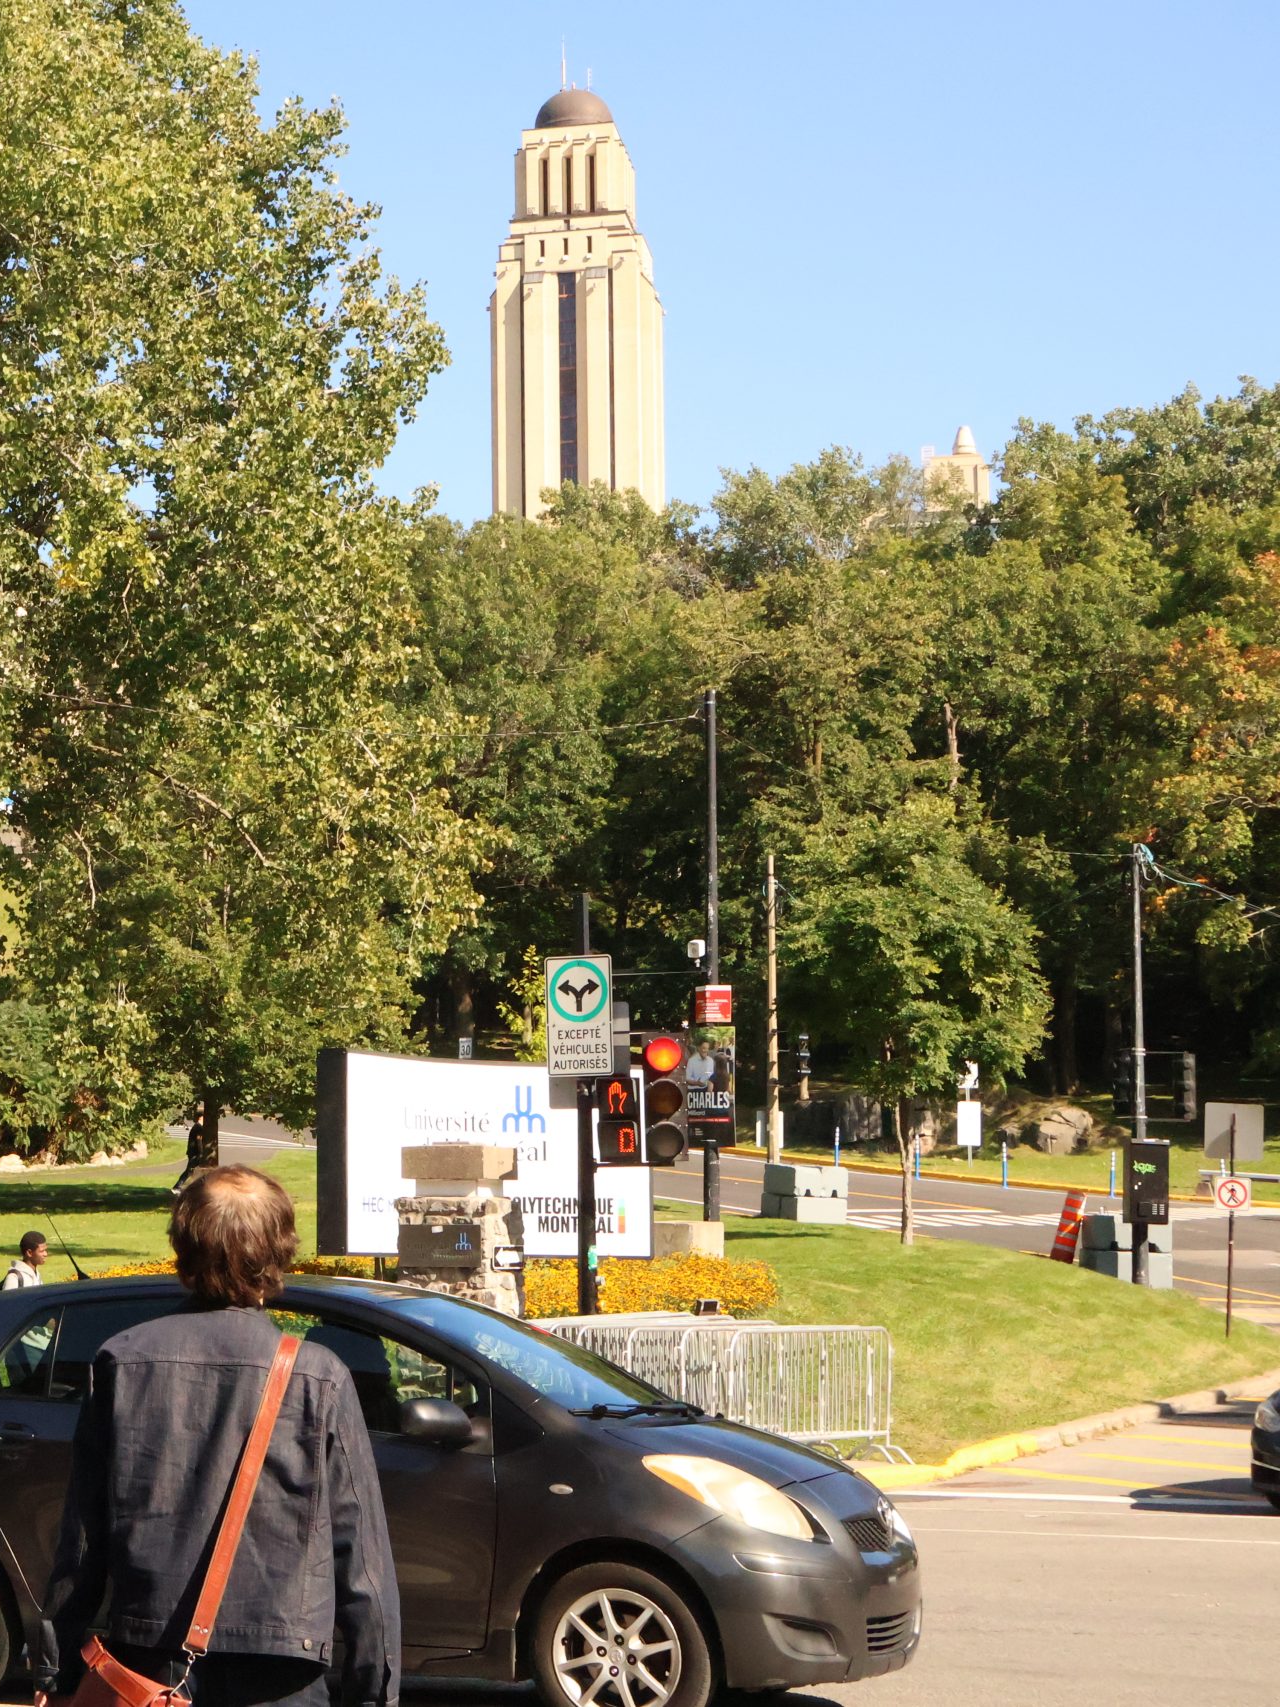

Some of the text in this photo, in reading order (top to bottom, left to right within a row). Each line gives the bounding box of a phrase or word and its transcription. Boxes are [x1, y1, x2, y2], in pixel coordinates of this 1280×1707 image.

[558, 1026, 601, 1040] EXCEPTÉ
[461, 1044, 471, 1056] 30
[553, 1042, 608, 1055] VÉHICULES
[553, 1056, 608, 1070] AUTORISÉS
[687, 1091, 730, 1109] CHARLES
[401, 1105, 490, 1134] Université
[362, 1195, 384, 1213] HEC
[538, 1215, 614, 1234] MONTAL
